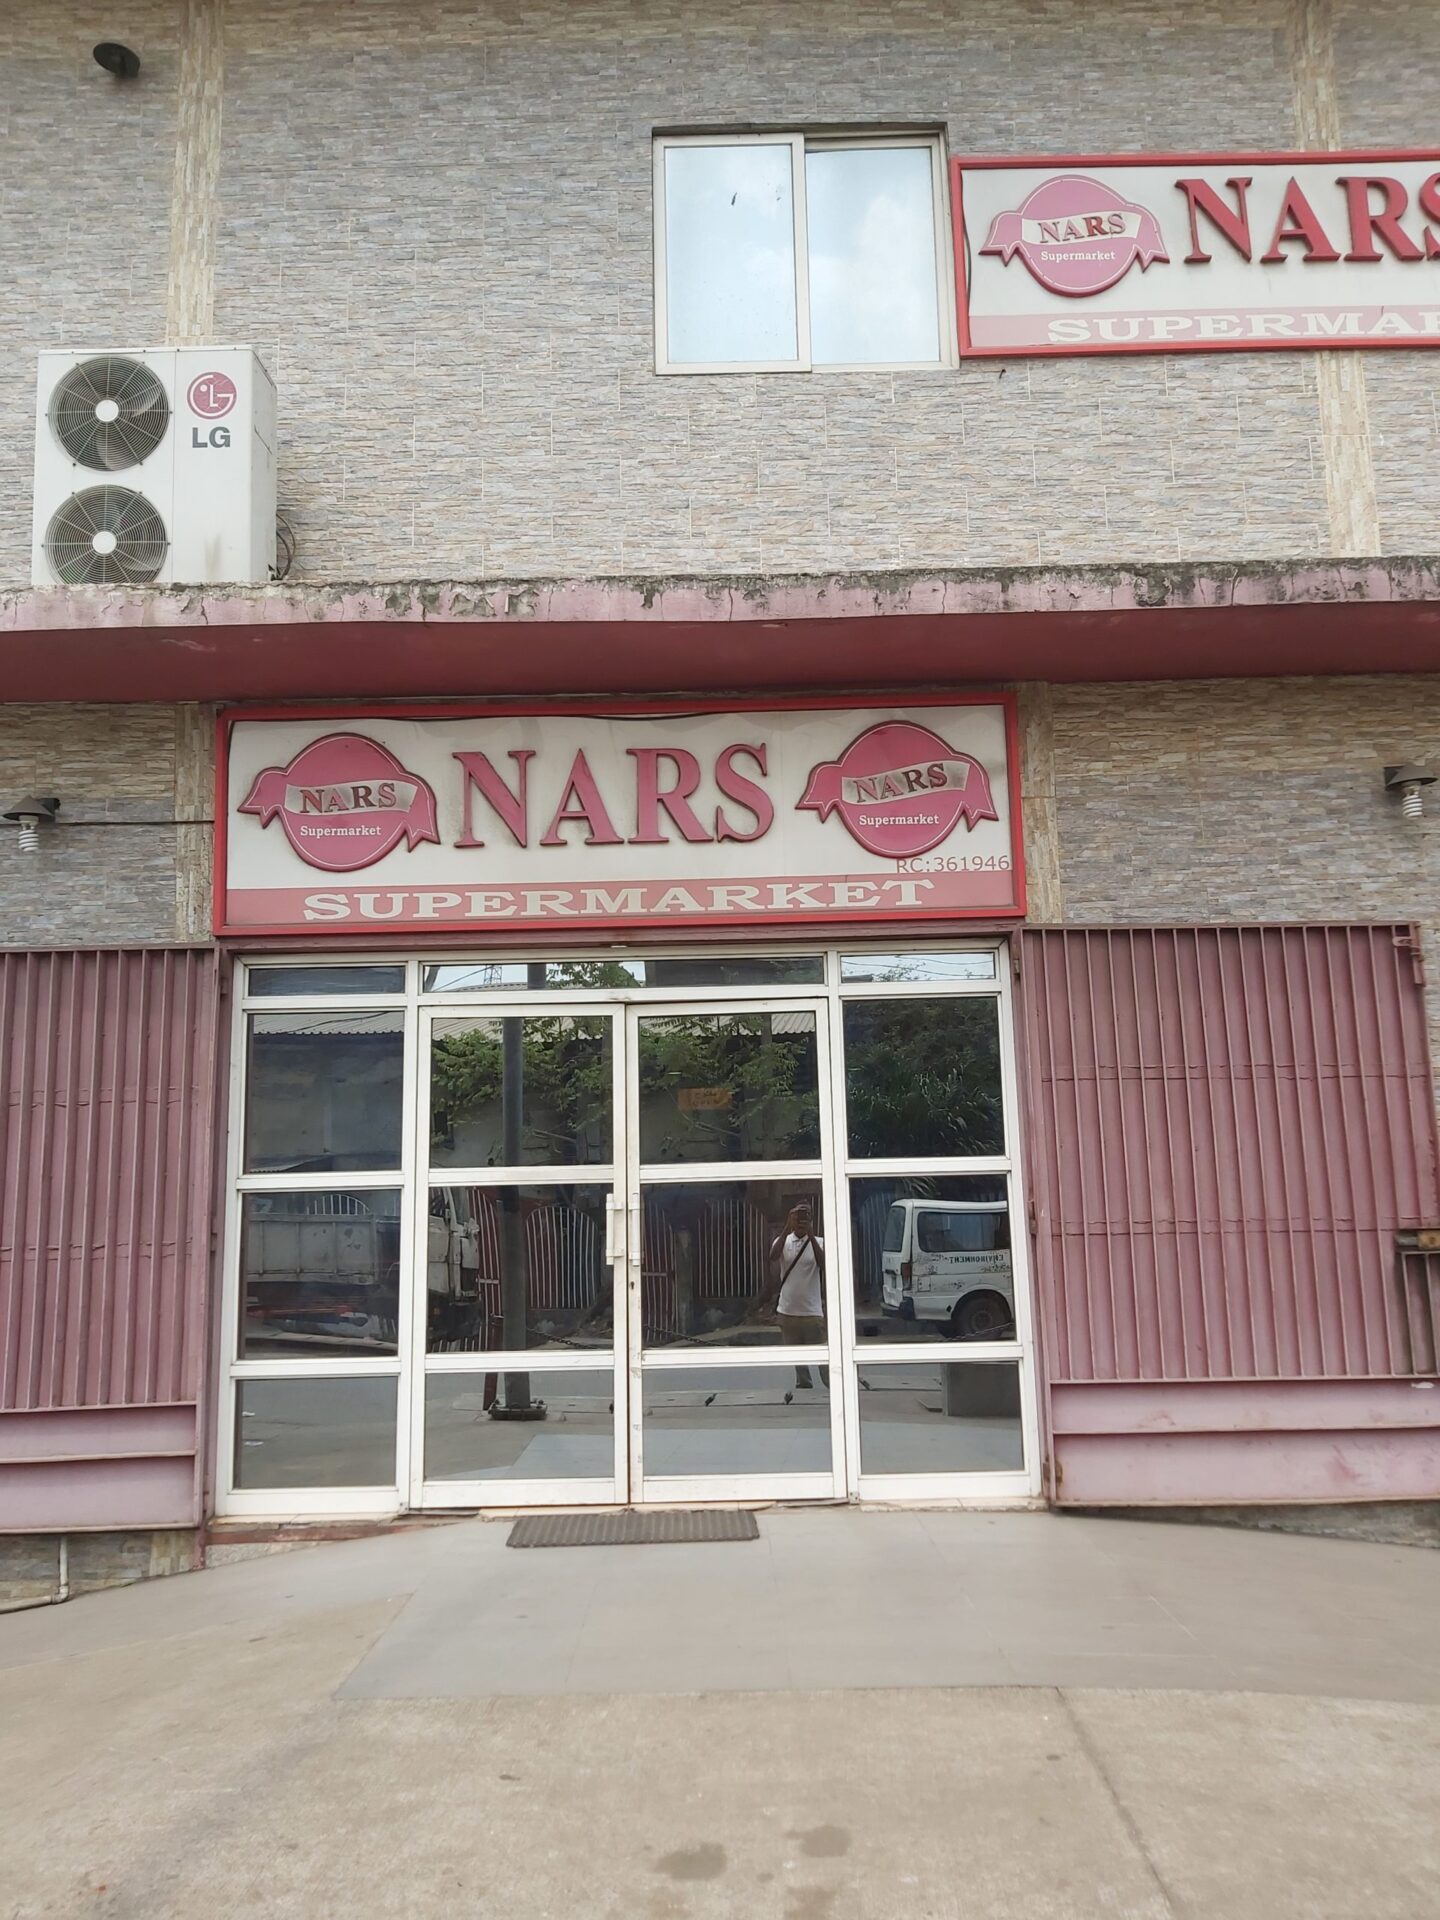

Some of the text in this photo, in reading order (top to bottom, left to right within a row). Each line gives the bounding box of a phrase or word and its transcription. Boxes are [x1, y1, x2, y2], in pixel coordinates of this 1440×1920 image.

[1039, 212, 1127, 244] NARS
[1040, 250, 1116, 264] Supermarket
[192, 426, 231, 449] LG
[452, 742, 775, 849] NARS
[855, 762, 949, 804] NARS
[298, 781, 397, 815] NARS
[299, 824, 382, 840] Supermarket
[858, 813, 940, 829] Supermarket
[896, 855, 1010, 874] RC:361946
[303, 879, 934, 921] SUPERMARKET
